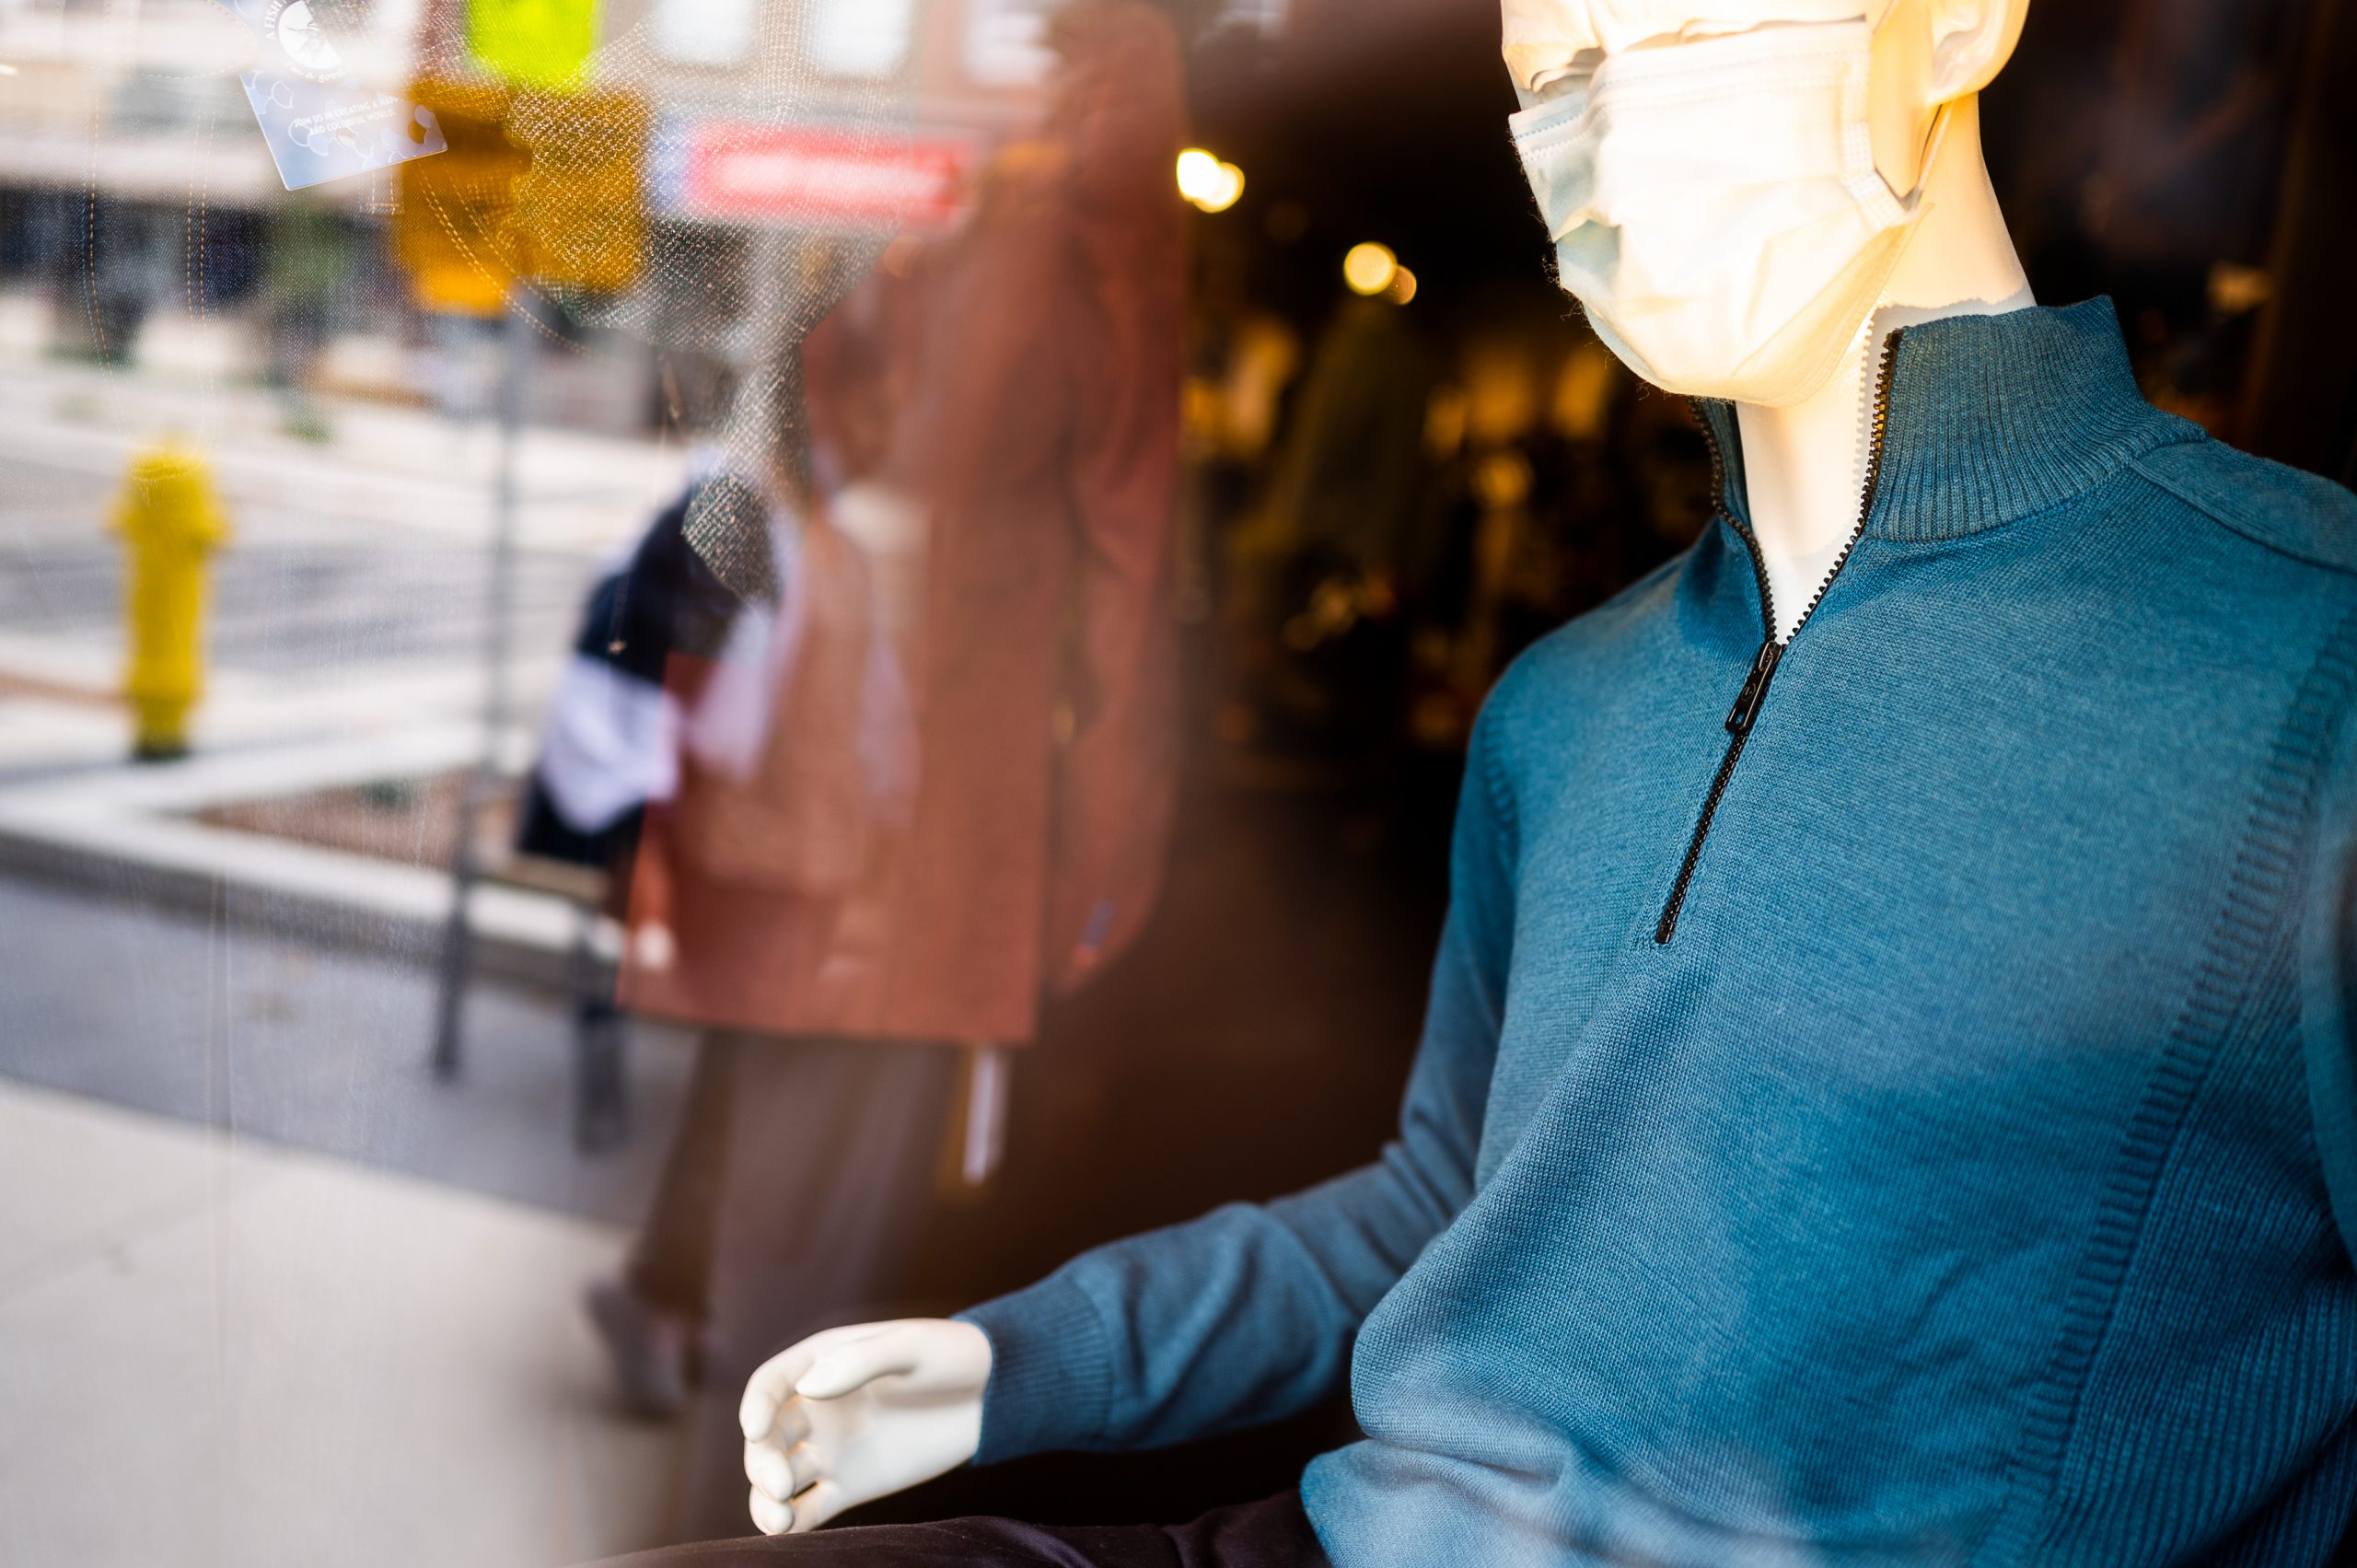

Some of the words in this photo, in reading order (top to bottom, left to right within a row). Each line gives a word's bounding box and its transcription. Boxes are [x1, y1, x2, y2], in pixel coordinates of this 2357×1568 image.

[264, 0, 283, 28] FISH
[293, 116, 312, 128] JOIN
[312, 113, 324, 123] US
[323, 110, 333, 120] IN
[333, 101, 372, 118] CREATING
[372, 100, 378, 109] A
[378, 95, 404, 107] HAPP
[308, 125, 326, 135] AND
[327, 116, 366, 132] COLORFUL
